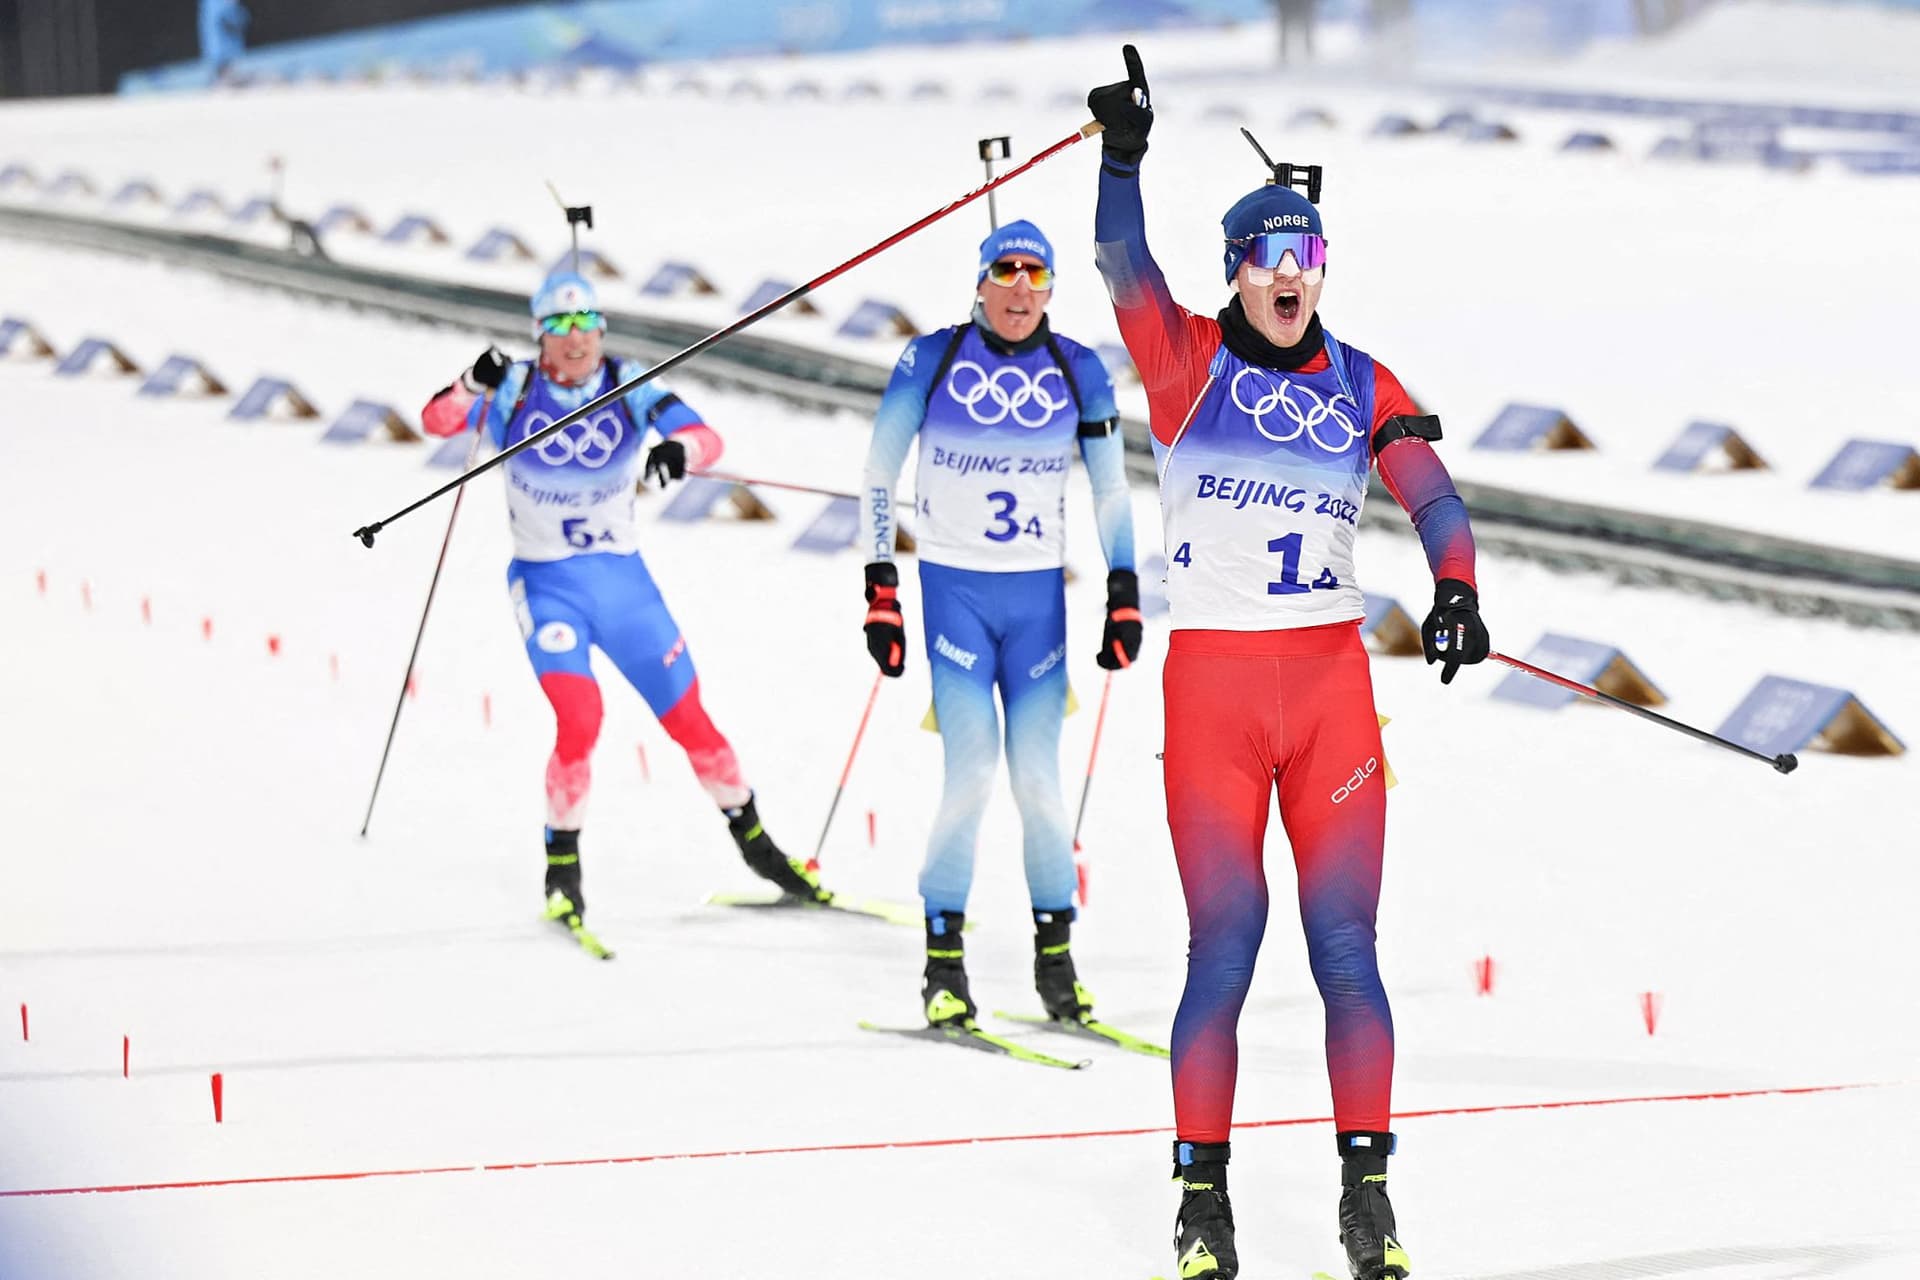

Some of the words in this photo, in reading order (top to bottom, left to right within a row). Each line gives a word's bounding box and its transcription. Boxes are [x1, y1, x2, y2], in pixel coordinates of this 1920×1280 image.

[1264, 214, 1310, 231] NORGE
[933, 447, 1011, 476] BEIJING
[984, 491, 1021, 542] 3
[1197, 474, 1307, 513] BEIJING
[1314, 493, 1359, 526] 2022
[1173, 541, 1192, 568] 4
[1267, 532, 1312, 595] 1
[934, 634, 978, 671] FRANCE
[1331, 756, 1377, 804] odlo
